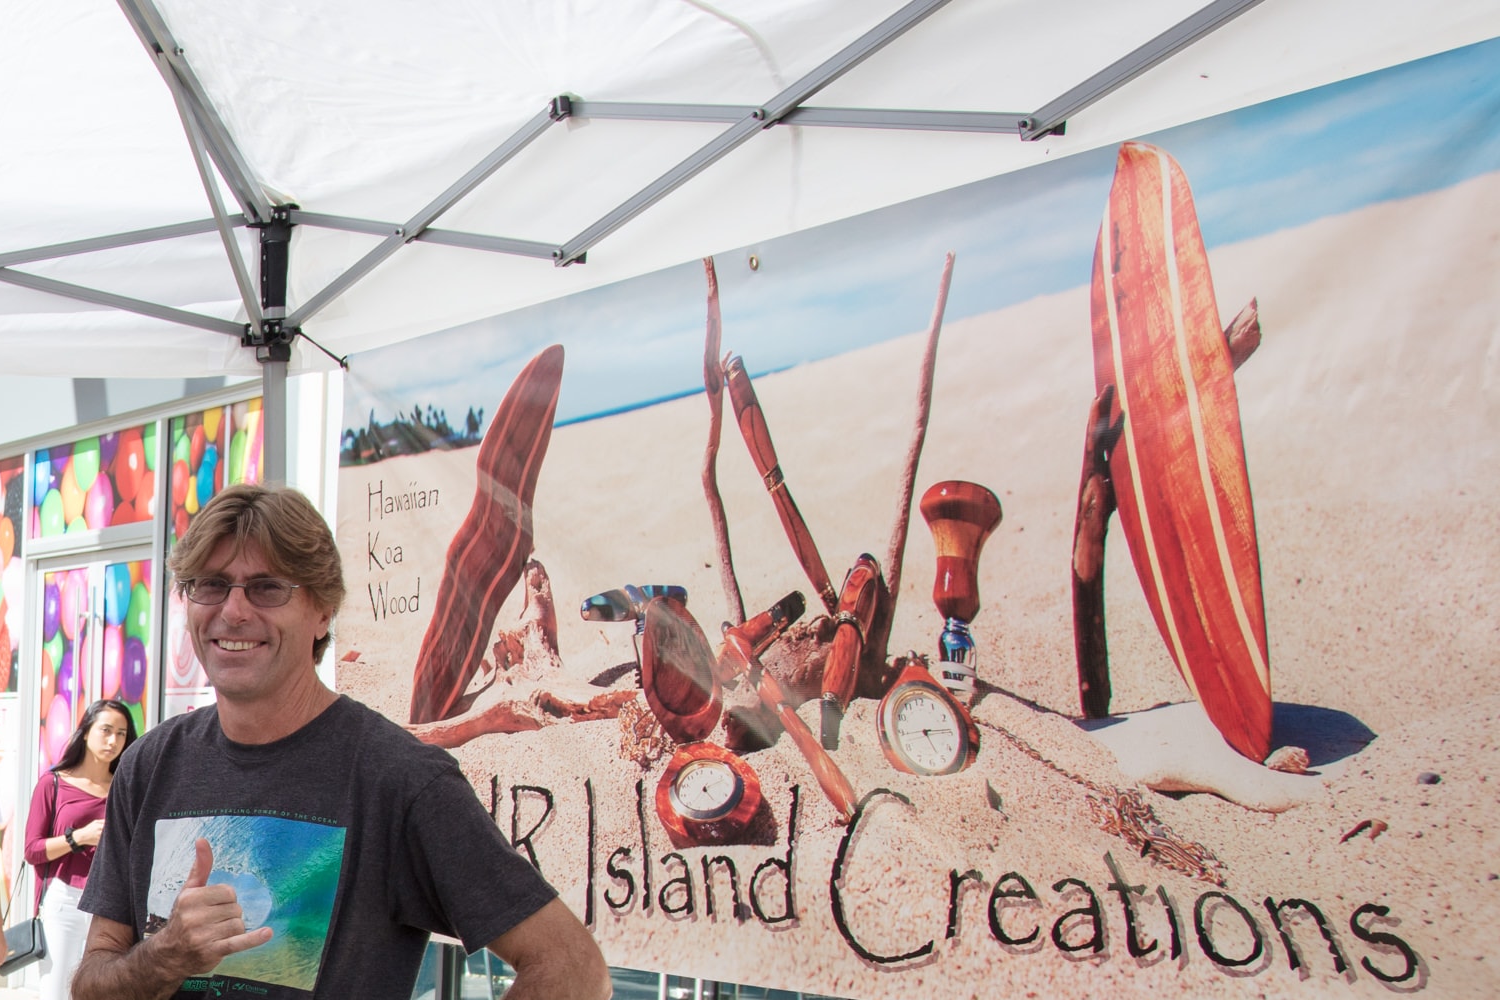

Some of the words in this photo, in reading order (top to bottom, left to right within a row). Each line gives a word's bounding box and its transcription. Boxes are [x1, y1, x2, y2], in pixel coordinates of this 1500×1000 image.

[368, 480, 439, 522] Hawaiian
[368, 531, 403, 572] Koa
[368, 577, 420, 622] Wood
[294, 812, 309, 820] THE
[311, 815, 338, 825] OCEAN
[584, 776, 801, 928] Island
[830, 786, 1422, 985] Creations
